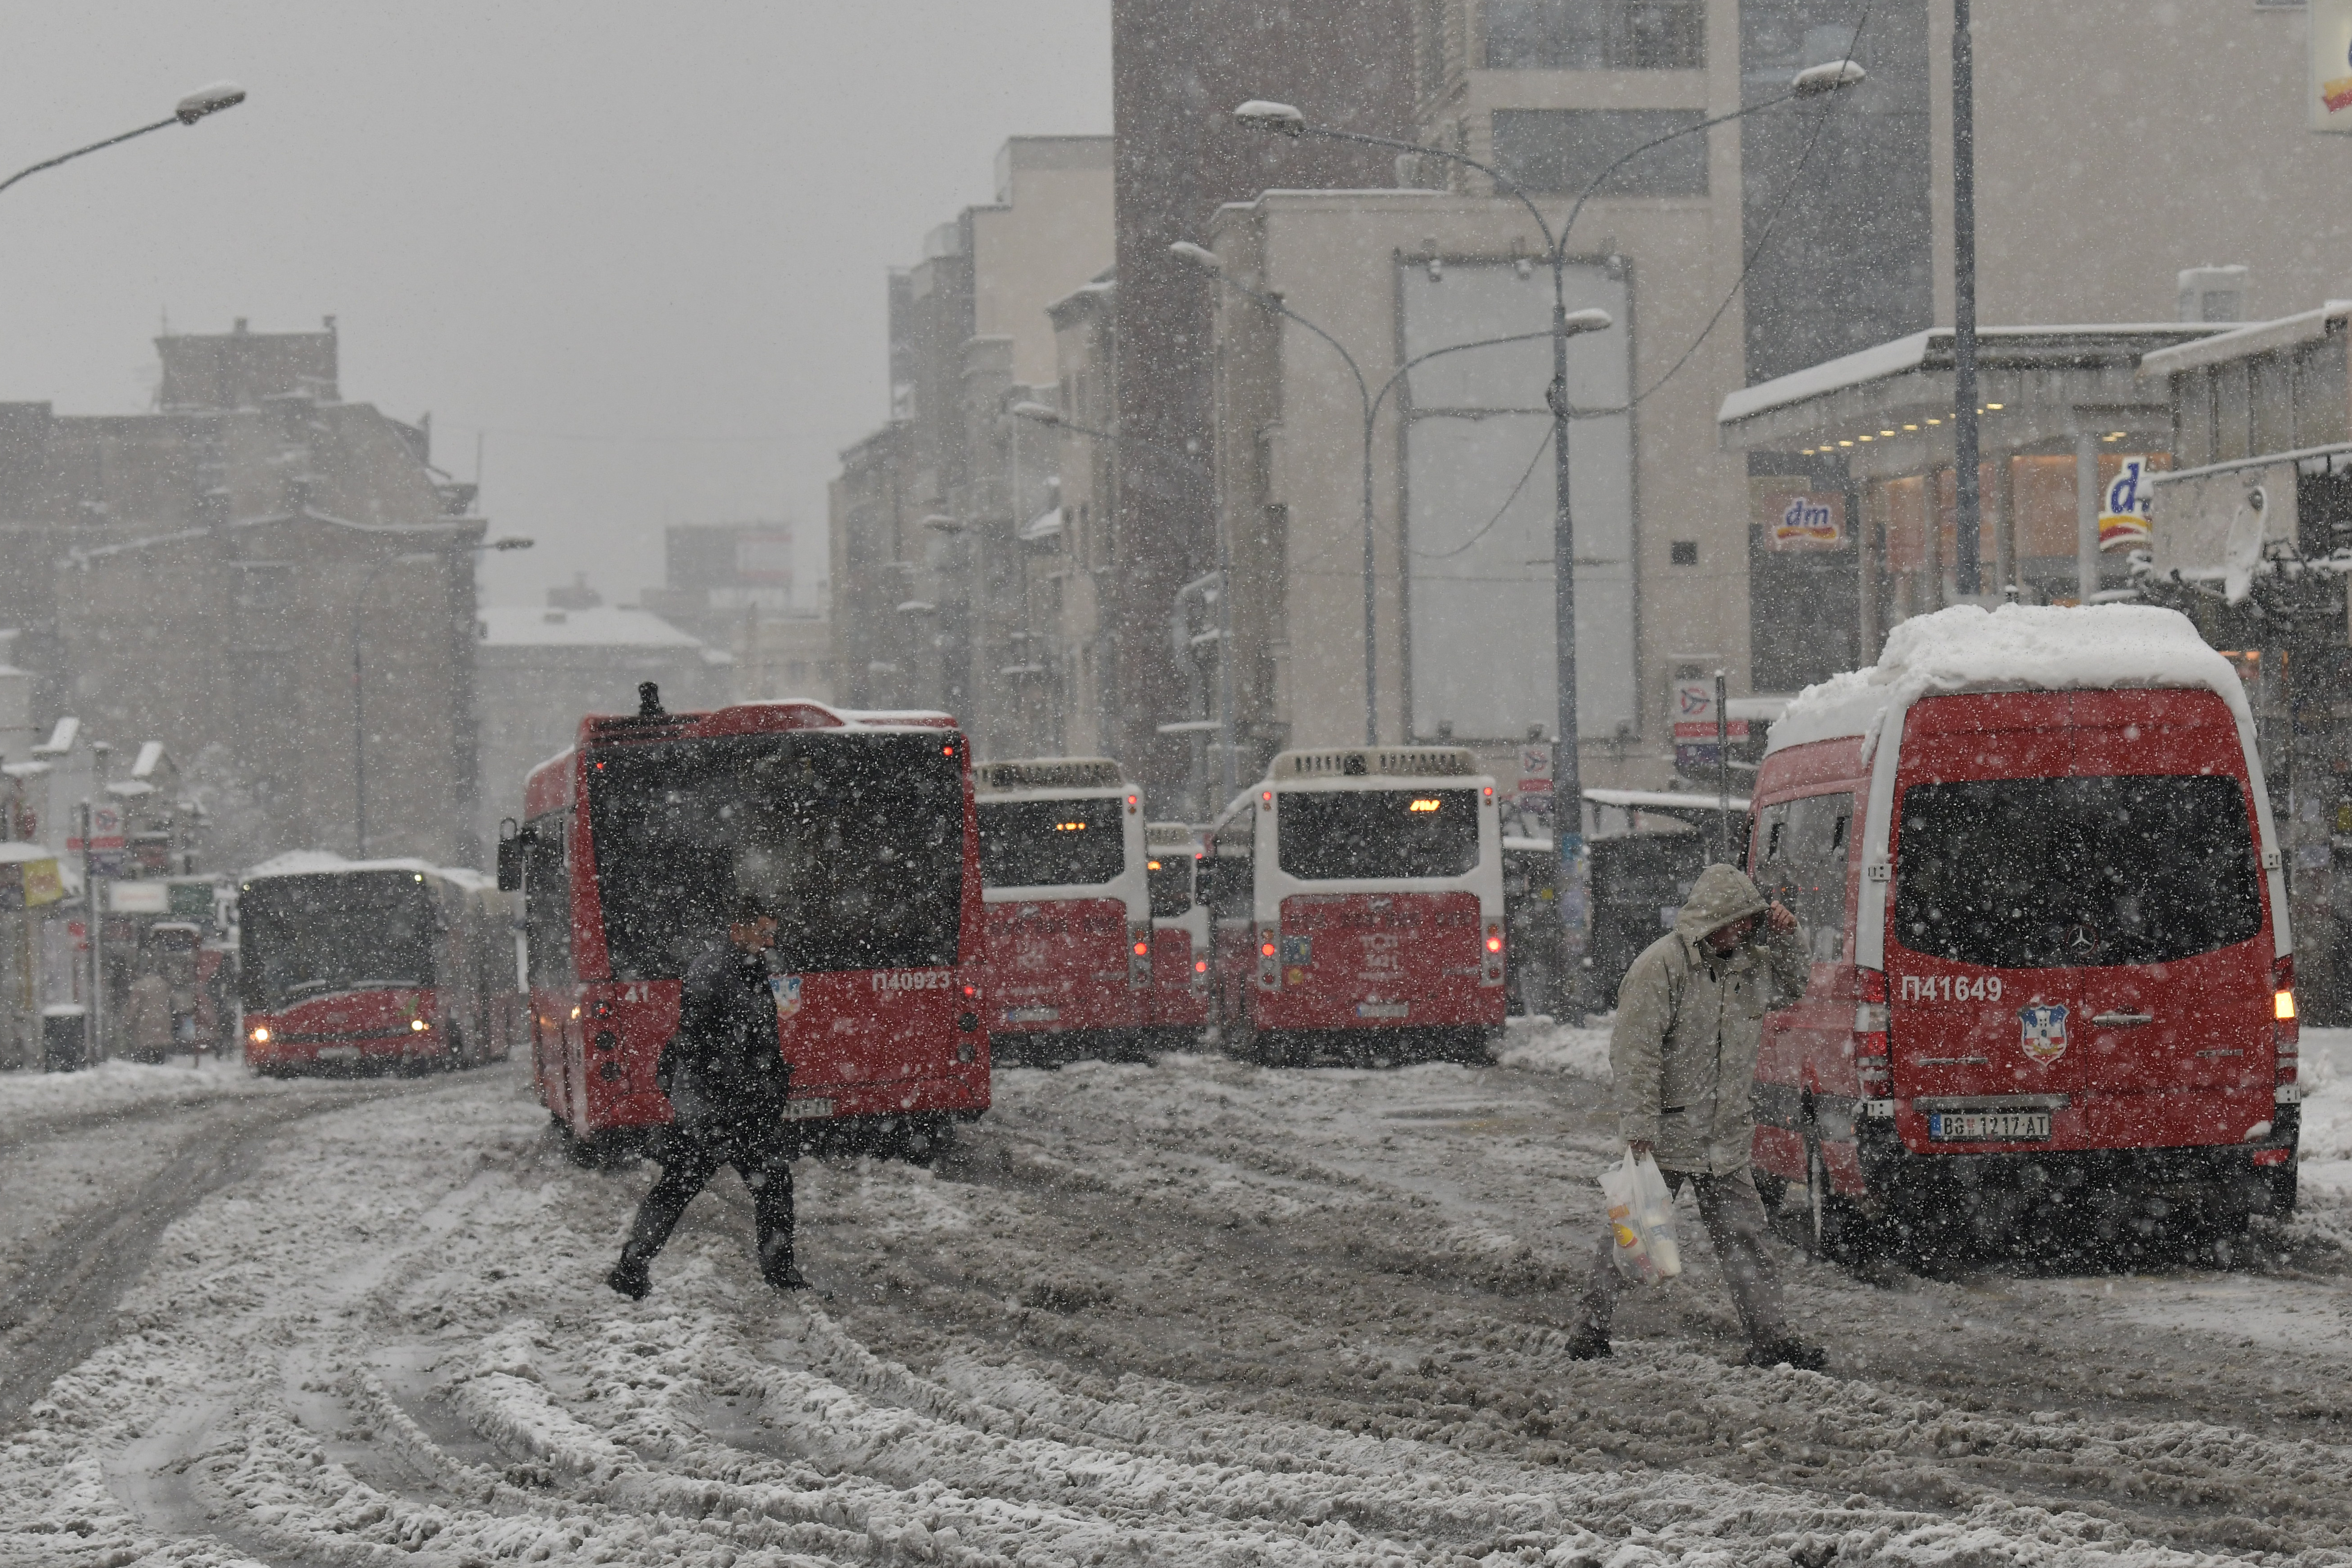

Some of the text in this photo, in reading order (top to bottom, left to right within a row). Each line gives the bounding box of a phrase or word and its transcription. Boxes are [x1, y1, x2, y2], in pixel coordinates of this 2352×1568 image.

[1786, 500, 1829, 526] dm
[872, 970, 950, 992] П40923
[1902, 976, 2002, 1002] П41649
[625, 985, 649, 1003] 41
[1944, 1117, 1964, 1135] BG
